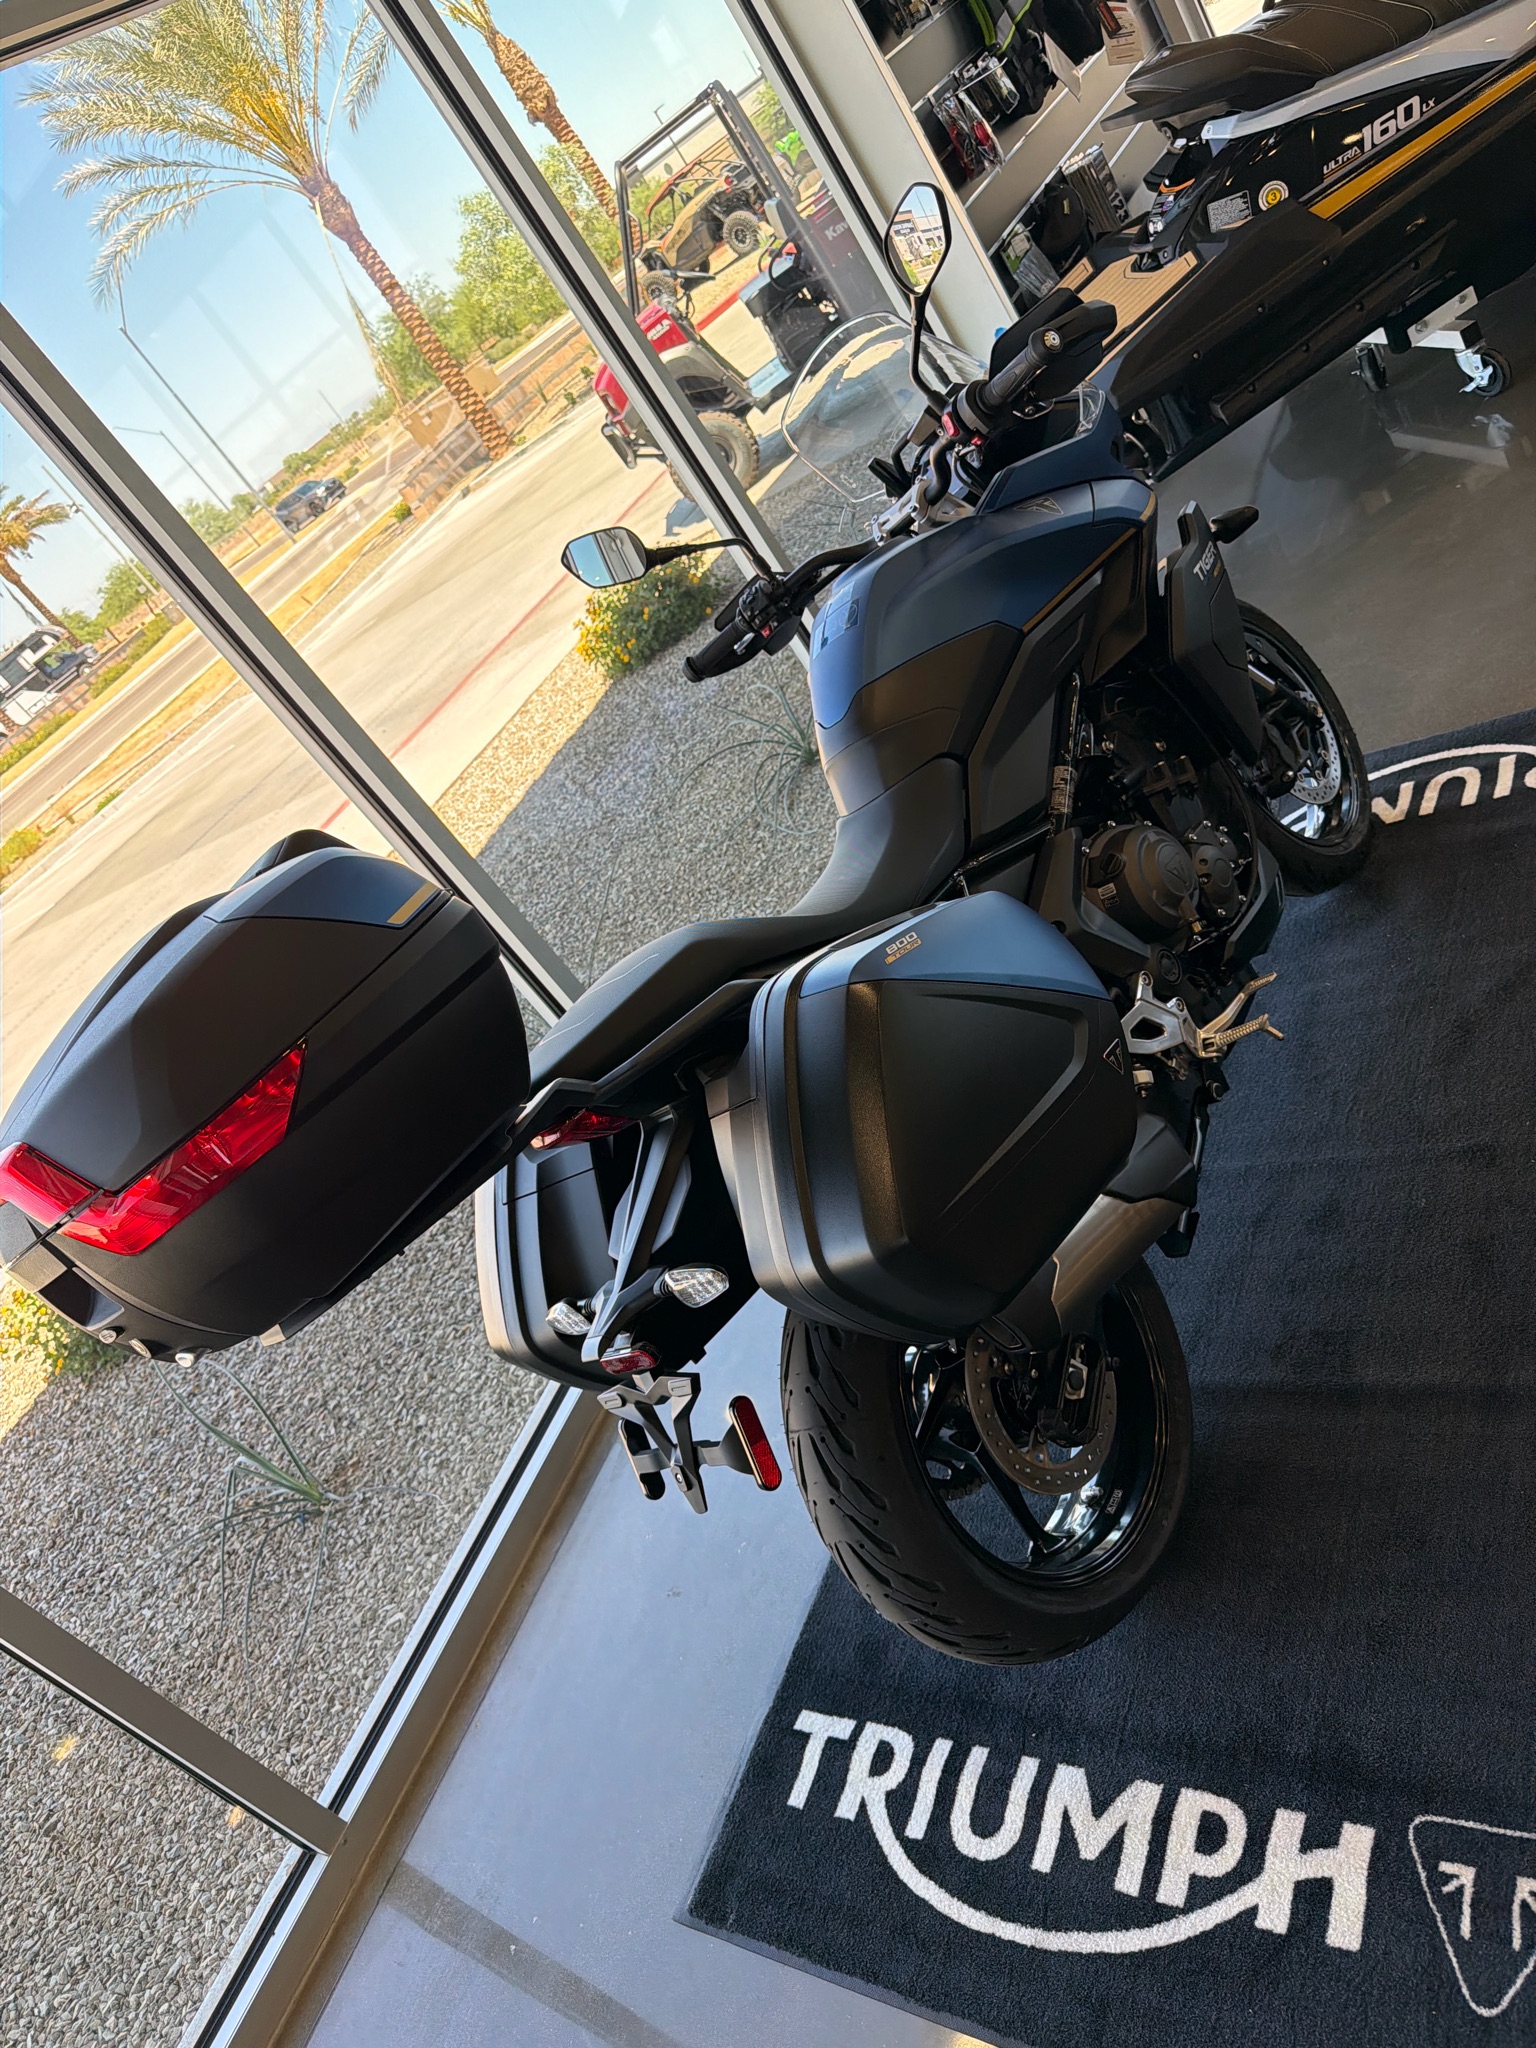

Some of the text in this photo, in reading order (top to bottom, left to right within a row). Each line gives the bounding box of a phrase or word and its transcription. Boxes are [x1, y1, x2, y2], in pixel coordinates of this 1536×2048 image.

[1323, 94, 1436, 174] ULTRA 160 LX
[1193, 541, 1217, 581] TIGER
[885, 931, 918, 955] 800
[889, 939, 920, 960] TOUR
[786, 1709, 1377, 1953] TRIUMPH
